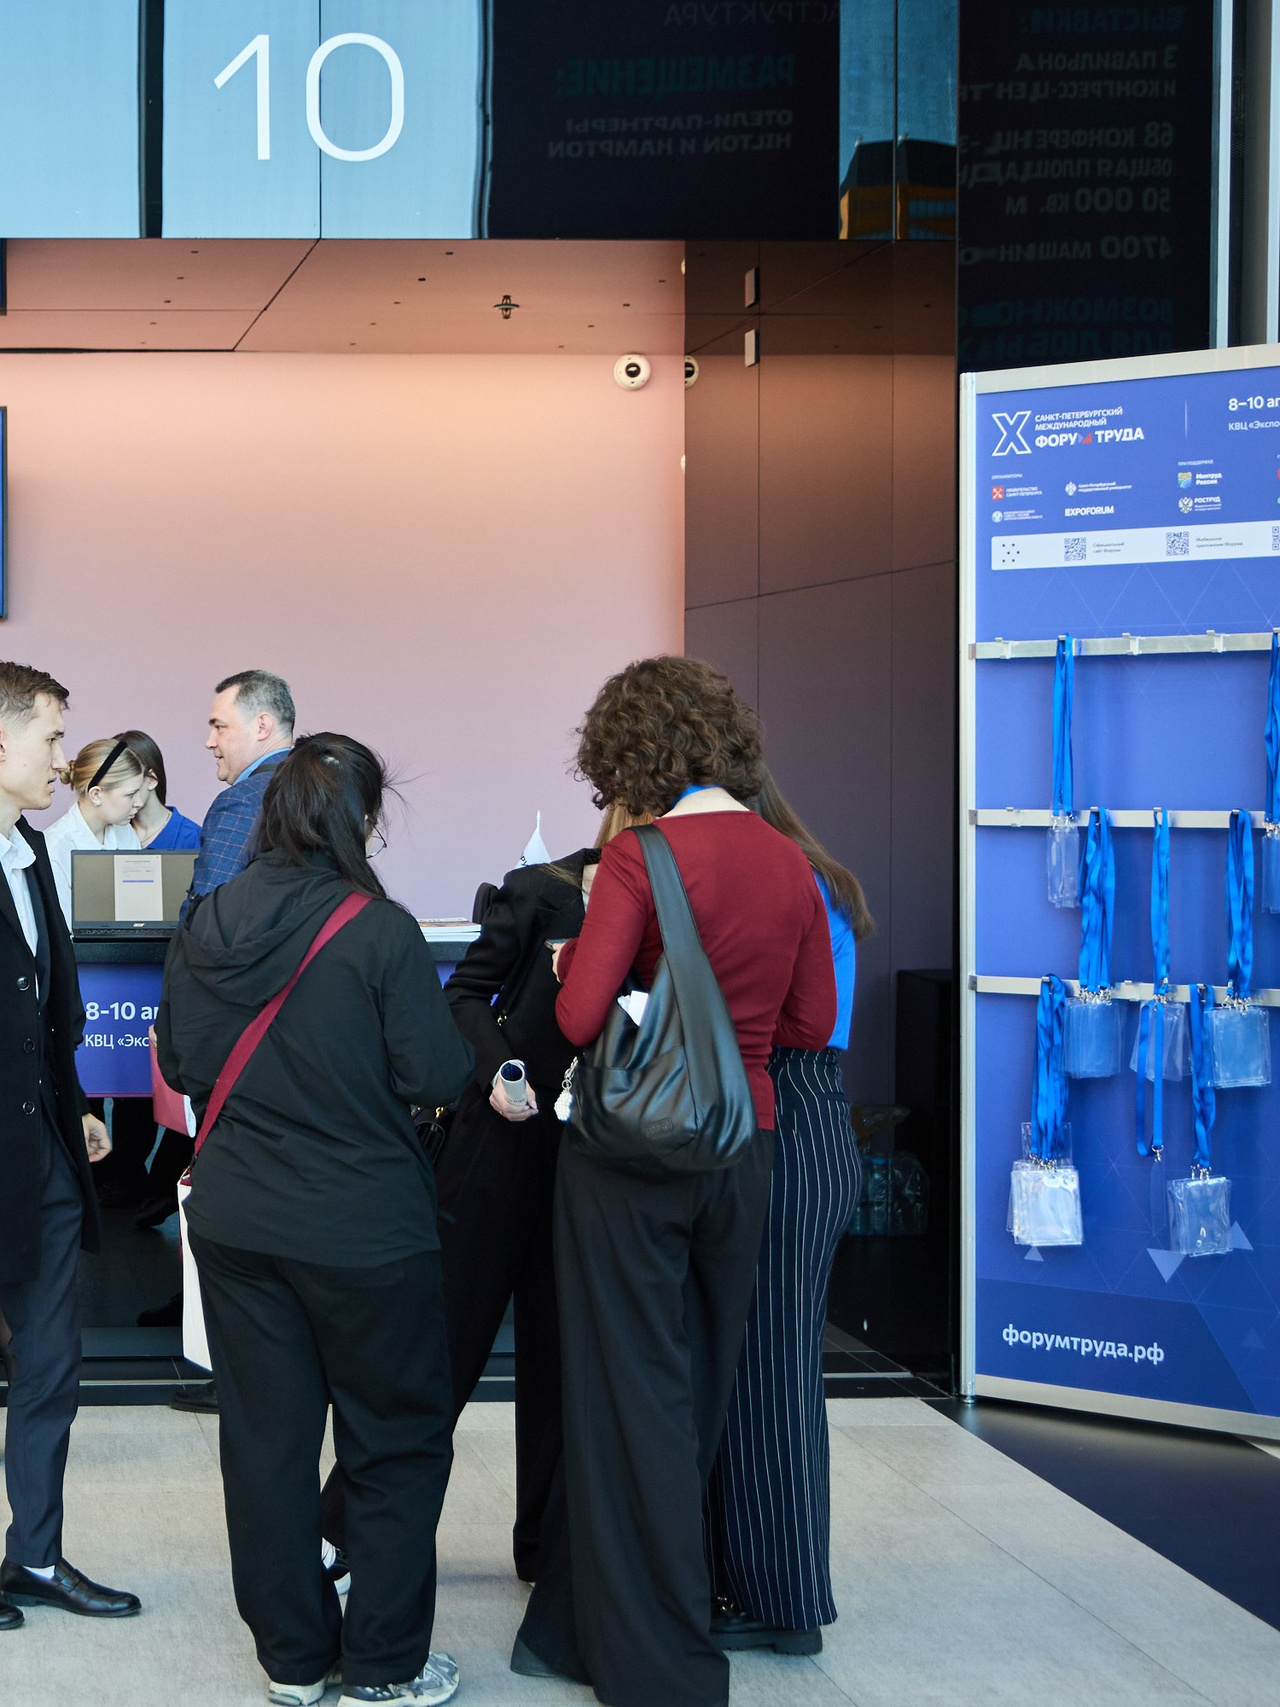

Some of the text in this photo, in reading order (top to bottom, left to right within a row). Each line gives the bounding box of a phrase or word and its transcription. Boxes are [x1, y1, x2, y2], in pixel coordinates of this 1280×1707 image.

[212, 31, 405, 163] 10
[1035, 406, 1123, 423] САНКТ-ПЕТЕРБУРГСКИЙ
[1035, 418, 1107, 431] МЕЖДУНАРОДНЫЙ
[1229, 422, 1248, 432] КВЦ
[1094, 427, 1145, 443] ТРУДА
[1064, 506, 1114, 517] EXPOFORUM
[85, 1034, 114, 1049] КВЦ
[1002, 1323, 1165, 1366] форумтруда.рф
